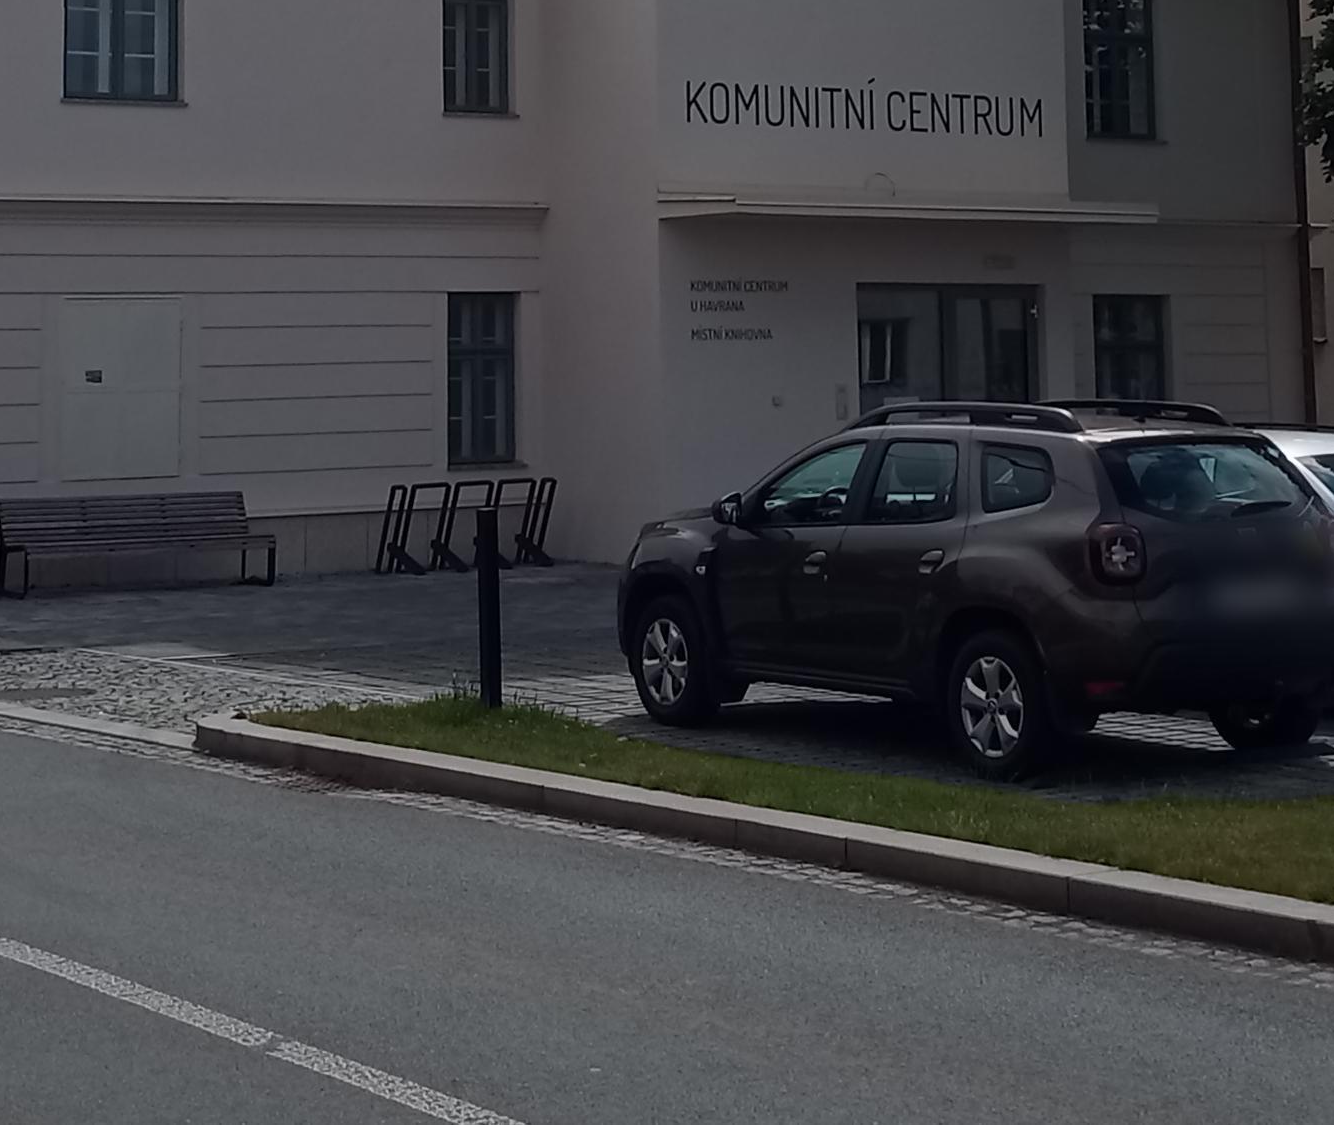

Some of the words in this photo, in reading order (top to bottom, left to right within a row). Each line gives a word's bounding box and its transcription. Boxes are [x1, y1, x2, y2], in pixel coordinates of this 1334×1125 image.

[686, 78, 875, 130] KOMUNITNÍ
[887, 90, 1043, 138] CENTRUM
[690, 276, 742, 292] KOMUNITNÍ
[743, 280, 788, 293] CENTRUM
[690, 300, 697, 312] U
[699, 300, 745, 312] HAVRANA
[691, 326, 722, 340] MÍSTNÍ
[724, 328, 773, 341] KNIHOVNA
